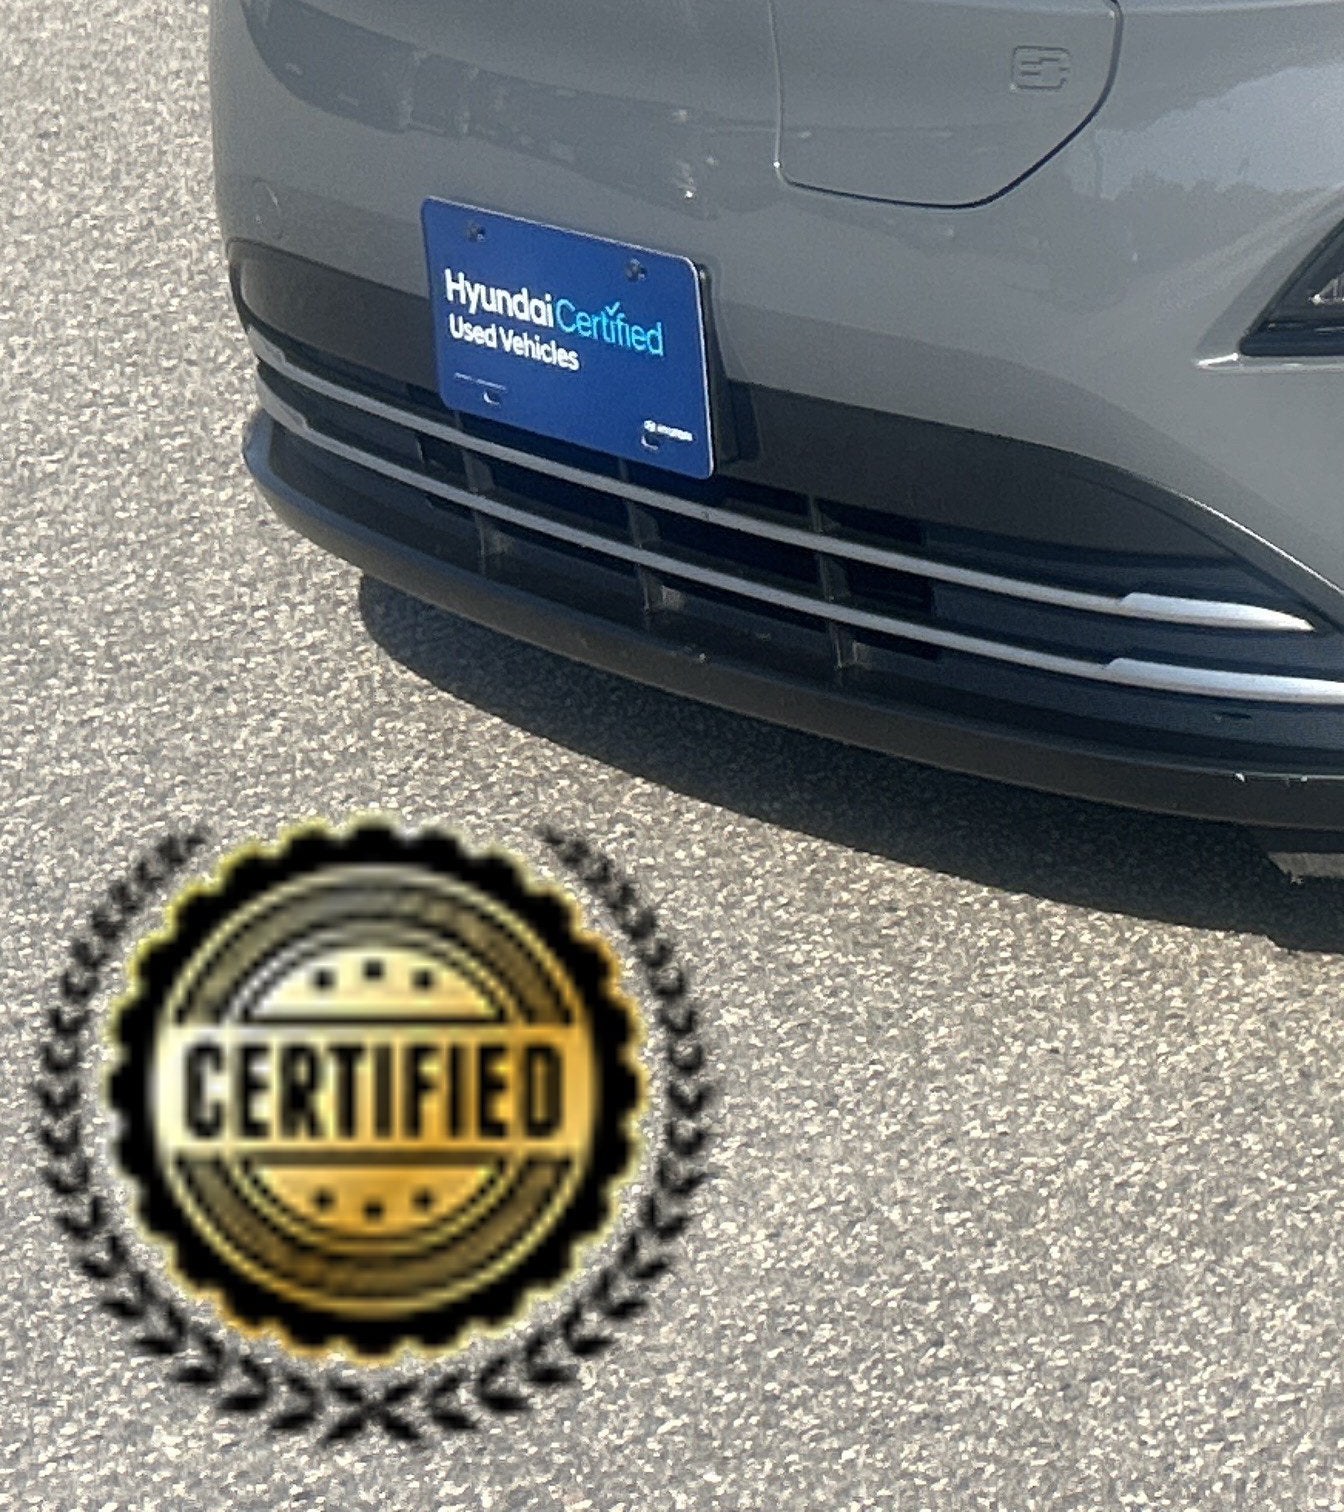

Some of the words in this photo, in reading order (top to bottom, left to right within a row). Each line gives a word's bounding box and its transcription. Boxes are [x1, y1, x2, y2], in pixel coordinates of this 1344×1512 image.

[444, 268, 555, 328] Hyundai
[554, 299, 664, 356] Certified
[449, 313, 498, 349] Used
[499, 326, 580, 371] Vehicles
